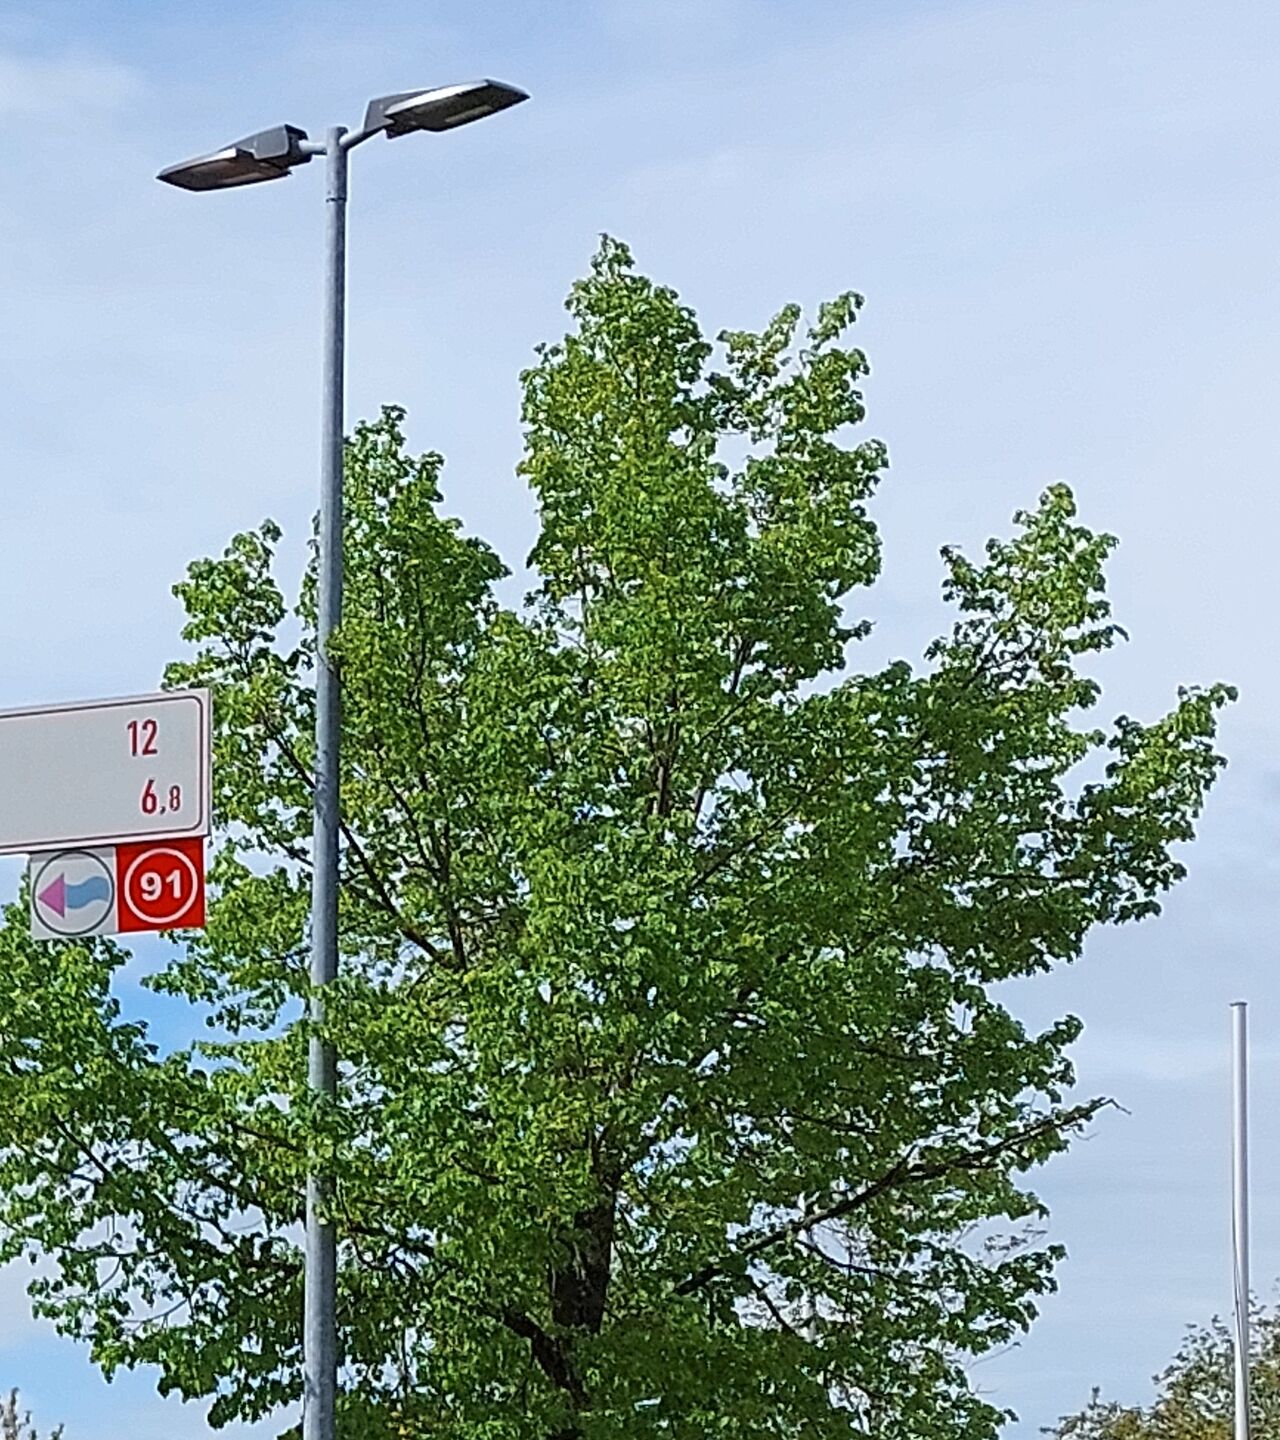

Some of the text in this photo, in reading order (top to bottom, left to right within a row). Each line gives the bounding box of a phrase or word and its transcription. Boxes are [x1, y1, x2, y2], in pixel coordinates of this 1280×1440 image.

[126, 718, 158, 757] 12
[141, 779, 181, 815] 6,8
[139, 868, 183, 901] 91
